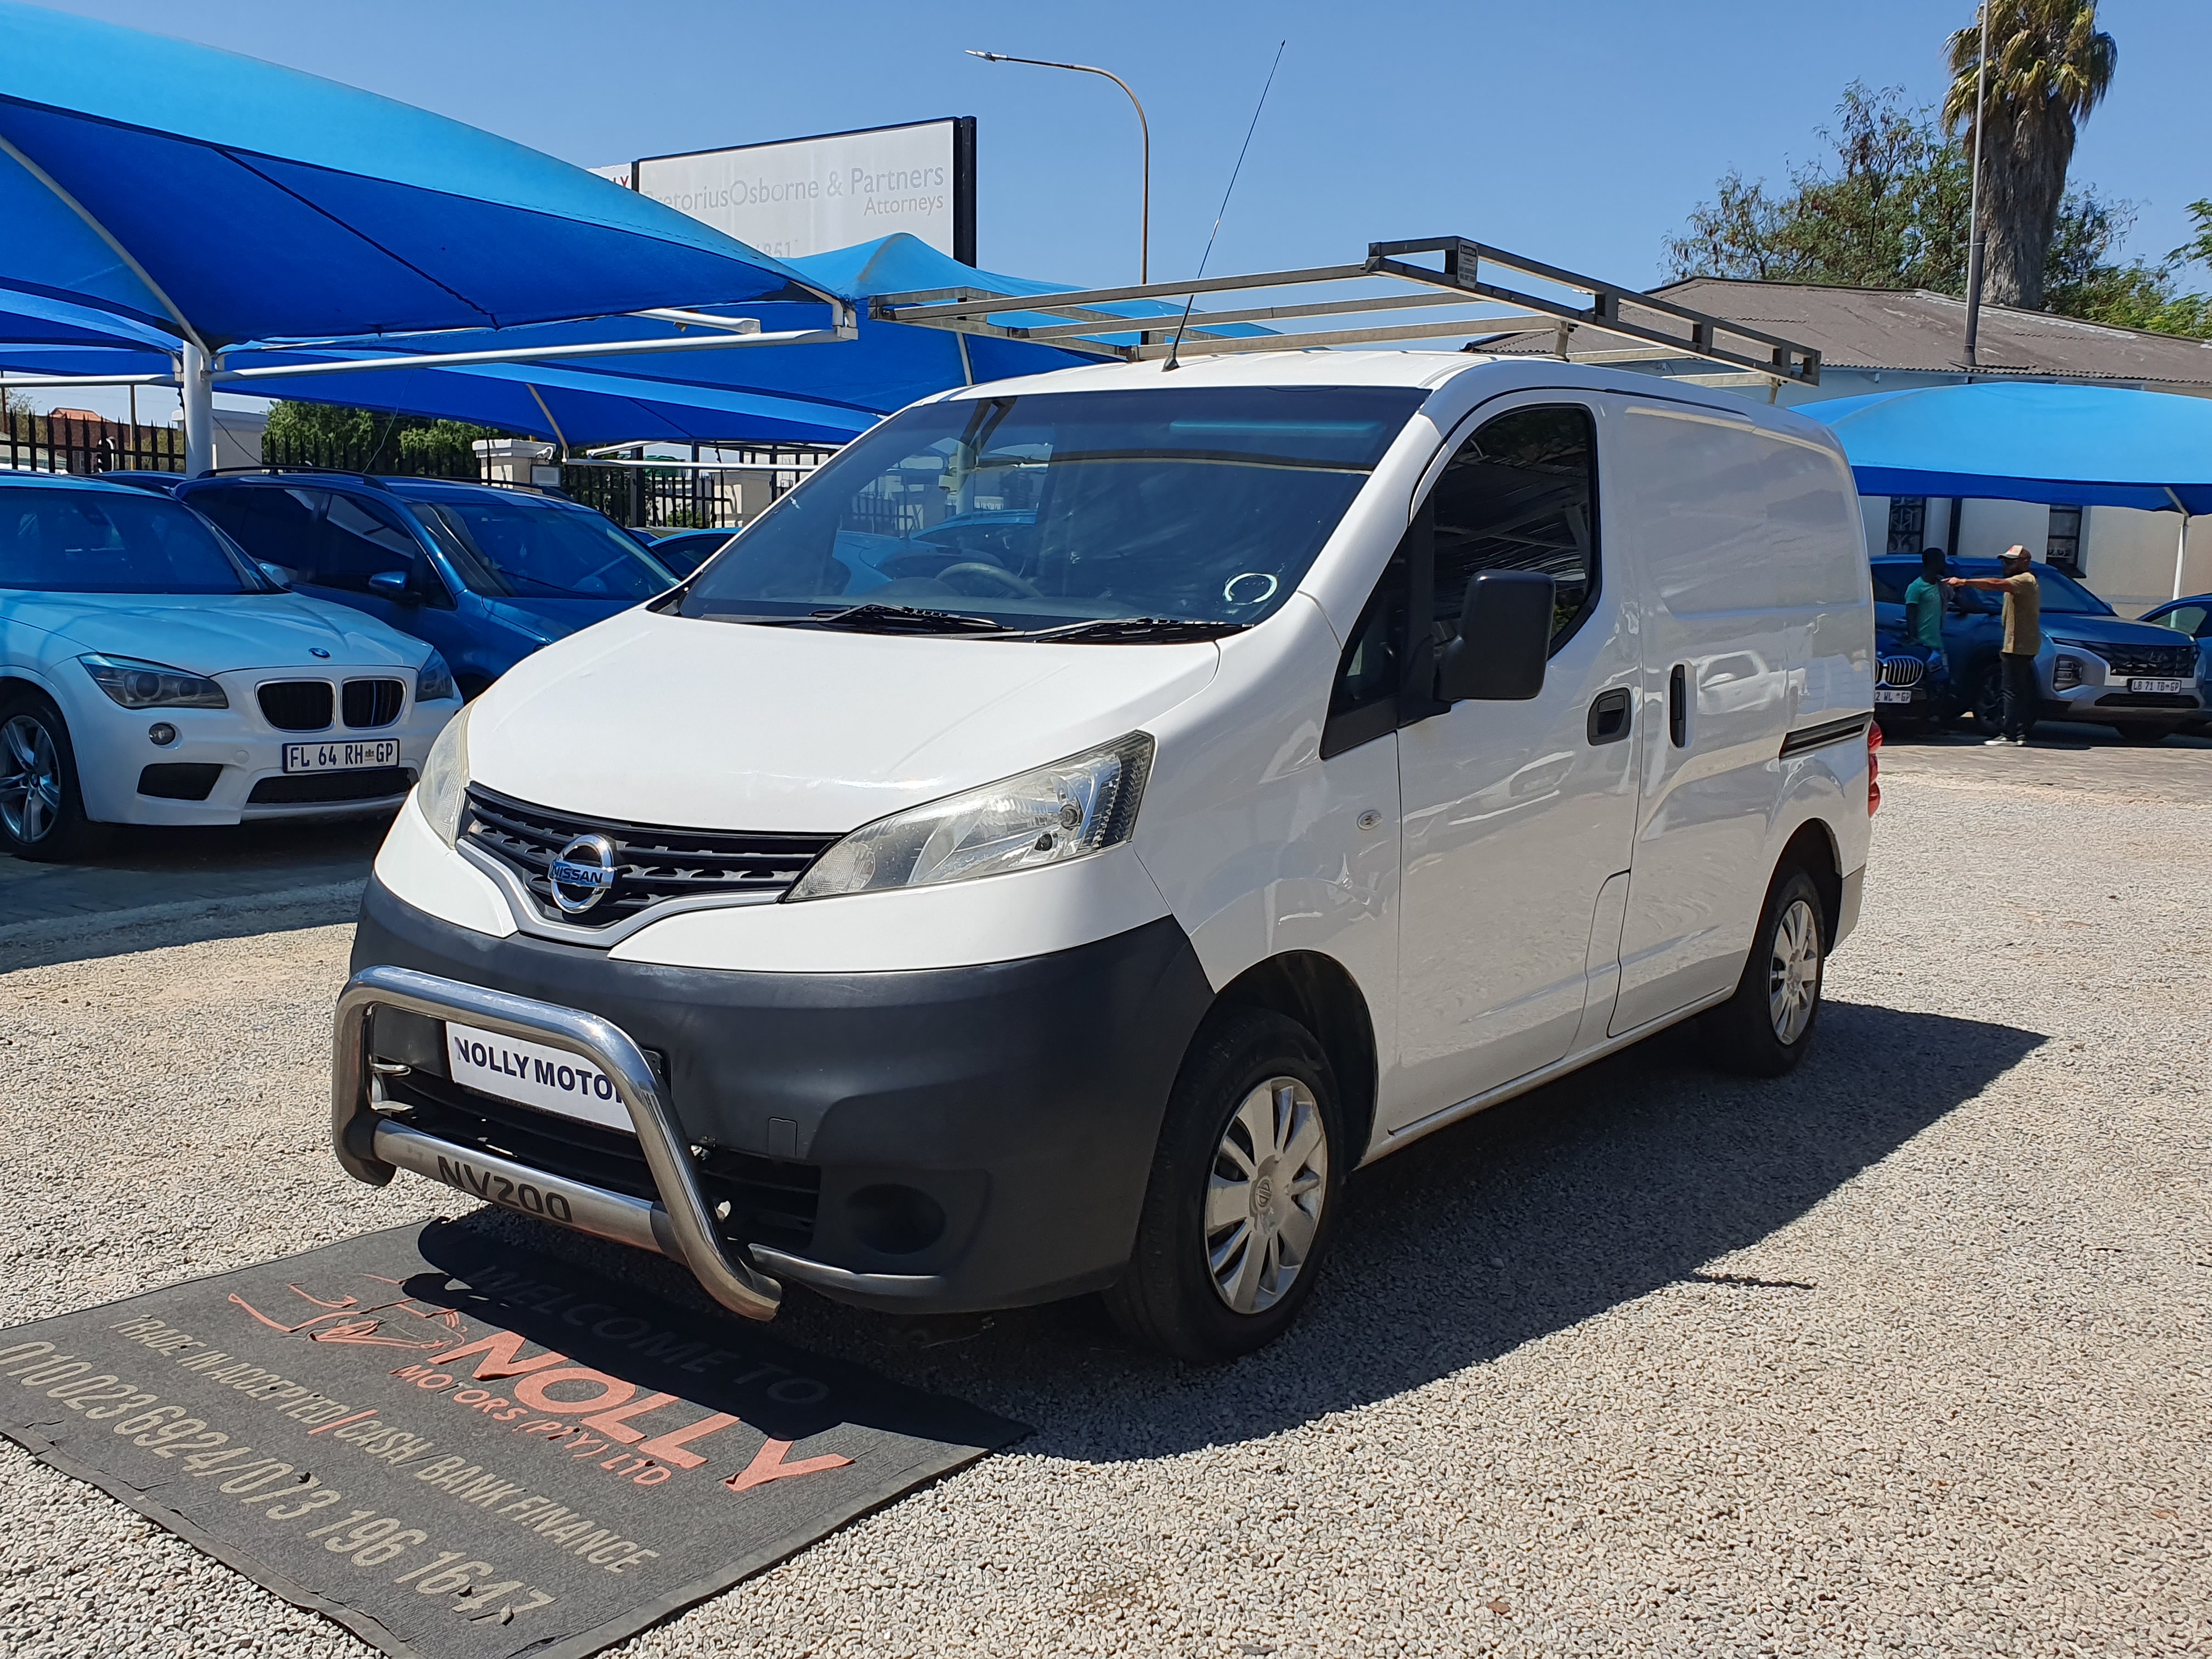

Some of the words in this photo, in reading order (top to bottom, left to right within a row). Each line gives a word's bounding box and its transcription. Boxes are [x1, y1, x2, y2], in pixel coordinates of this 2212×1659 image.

[827, 171, 843, 197] &
[851, 167, 944, 194] Partners
[864, 195, 944, 216] Attorneys
[755, 241, 791, 257] 851
[1901, 692, 1910, 701] GP
[2133, 681, 2142, 690] LB
[2170, 682, 2179, 691] GP
[291, 747, 310, 768] FL
[319, 746, 337, 765] 64
[345, 744, 363, 765] RH
[376, 743, 393, 763] GP
[552, 865, 603, 883] NISSAN
[454, 1036, 529, 1079] NOLLY
[534, 1059, 623, 1104] MOTO
[437, 1155, 573, 1223] NV200
[464, 1265, 740, 1373] WELCOME
[733, 1361, 830, 1403] TO
[427, 1330, 856, 1491] NOLLY
[109, 1314, 207, 1356] TRADE
[176, 1350, 235, 1370] IN
[496, 1495, 660, 1573] FINANCE
[512, 1420, 610, 1458] (PTY)
[599, 1453, 672, 1486] LTD
[306, 1510, 428, 1567] 196
